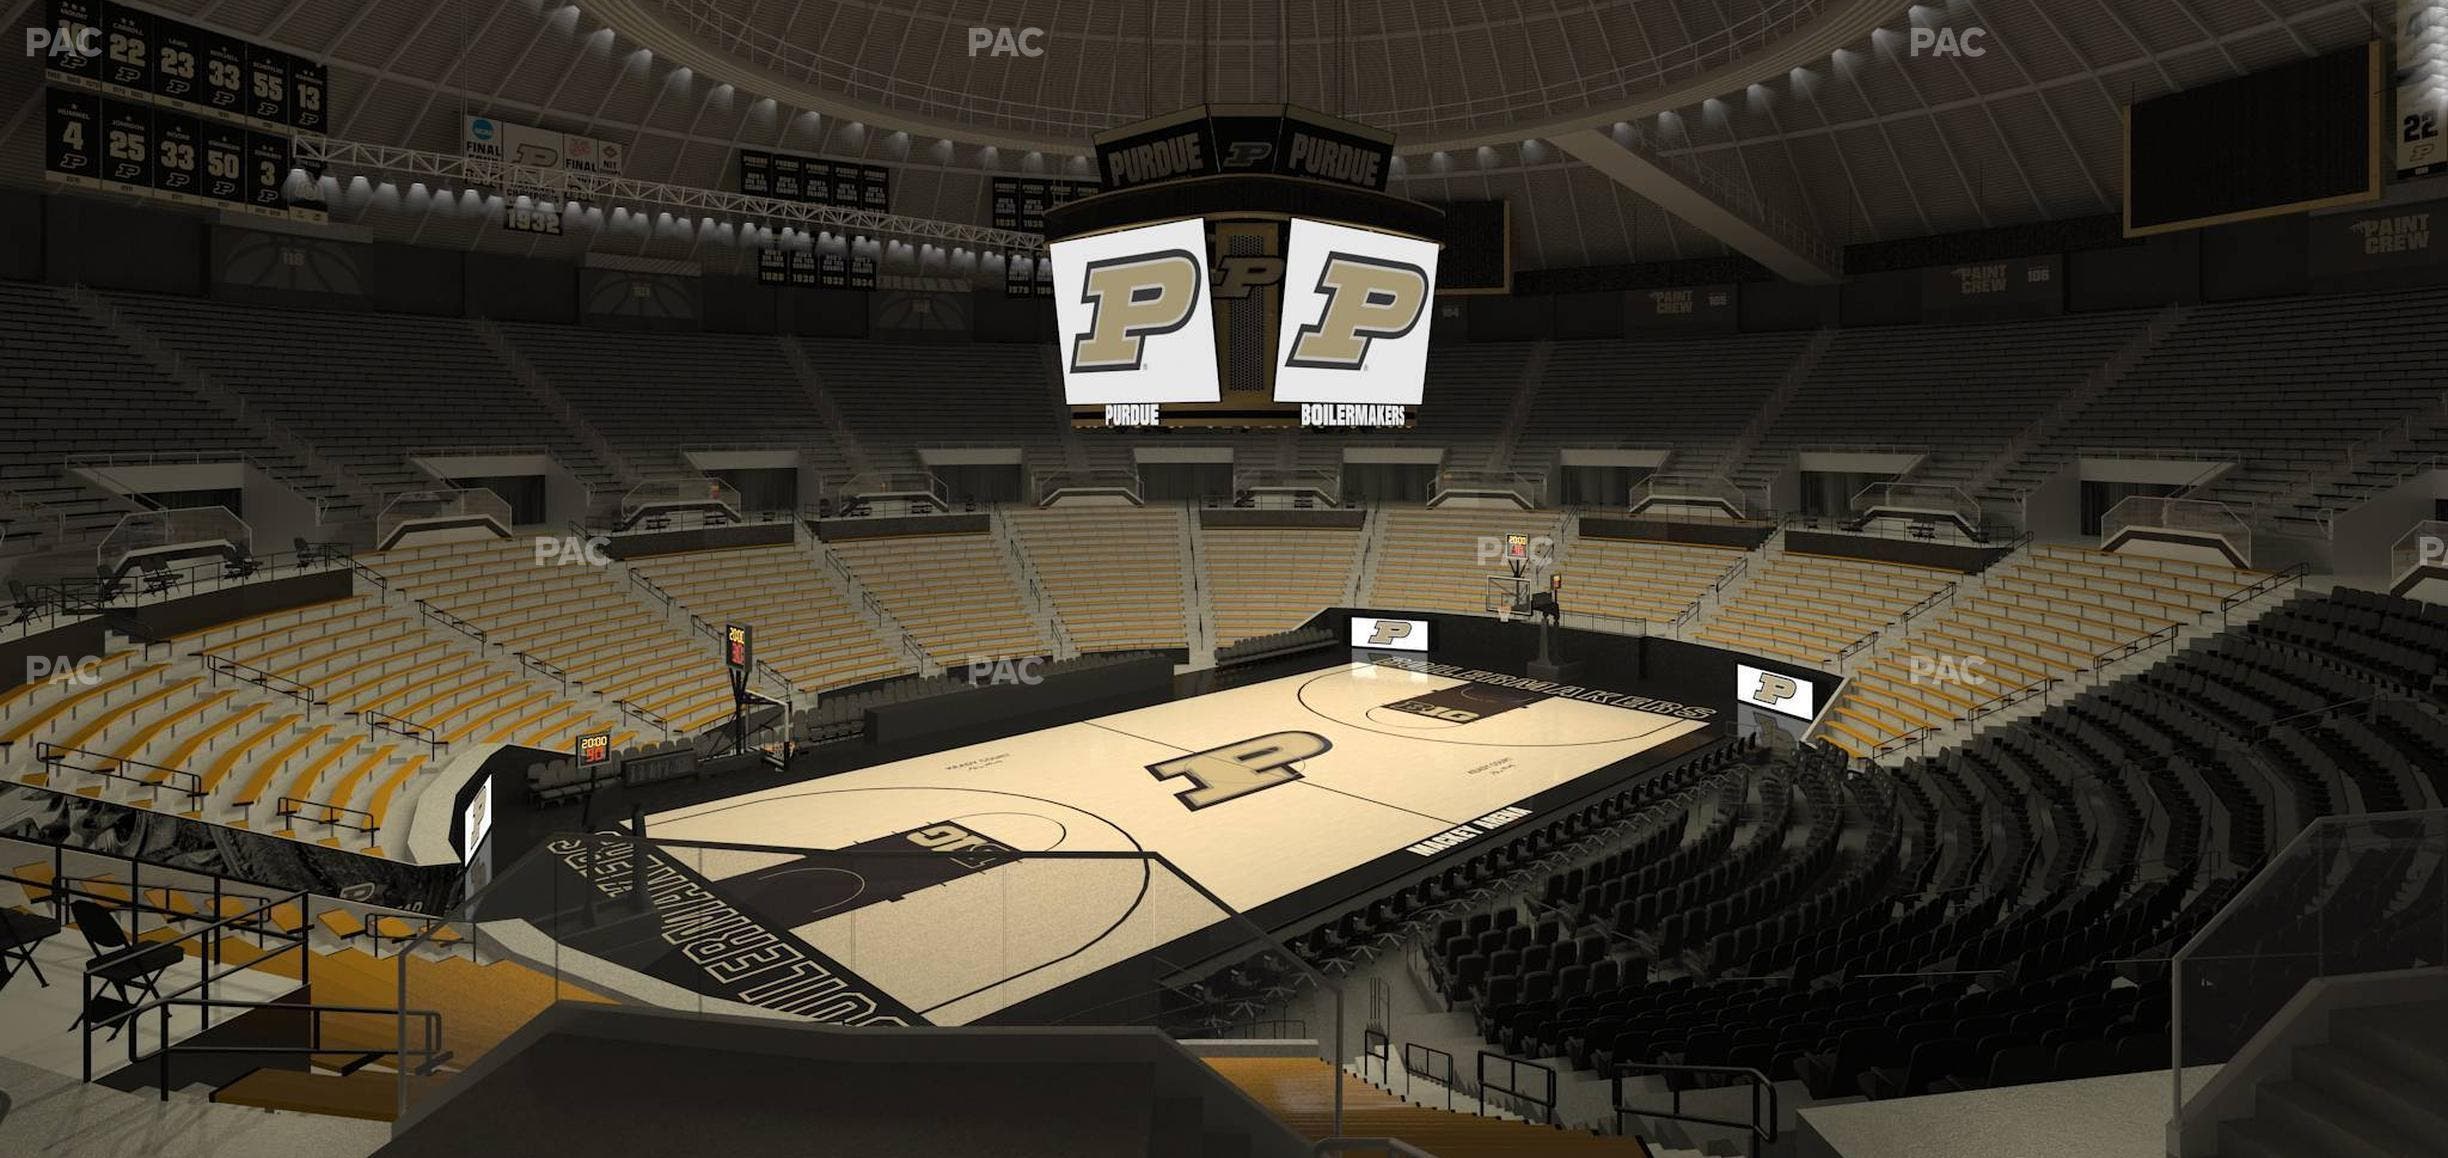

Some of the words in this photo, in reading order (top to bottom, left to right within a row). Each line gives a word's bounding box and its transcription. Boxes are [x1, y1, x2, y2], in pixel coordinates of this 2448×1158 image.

[109, 32, 146, 67] 22
[160, 47, 194, 79] 23
[208, 60, 240, 91] 33
[253, 71, 283, 102] 55
[296, 84, 320, 111] 13
[62, 121, 84, 150] 4
[2403, 111, 2438, 142] 22
[109, 130, 146, 162] 25
[160, 141, 194, 172] 33
[467, 141, 500, 156] FINAL
[1108, 132, 1204, 187] PURDUE
[1289, 132, 1382, 188] PURDUE
[207, 149, 240, 179] 50
[260, 160, 276, 186] 3
[566, 158, 596, 172] FINAL
[507, 207, 560, 233] 1932
[2362, 213, 2430, 238] PAINT
[2364, 231, 2430, 255] CREW
[1960, 278, 2007, 294] CREW
[1961, 264, 2007, 279] PAINT
[2028, 269, 2049, 282] 106
[1070, 249, 1201, 373] P
[1285, 251, 1429, 370] P
[1656, 302, 1695, 314] CREW
[1105, 404, 1159, 426] PURDUE
[1301, 404, 1405, 426] BOILERMAKERS
[1368, 620, 1412, 645] P
[1372, 656, 1717, 720] BOILERMAKERS
[1753, 672, 1798, 705] P
[581, 736, 608, 749] 20:00
[1144, 730, 1333, 812] P
[1406, 824, 1485, 857] MACKEY
[1472, 806, 1534, 830] ARENA
